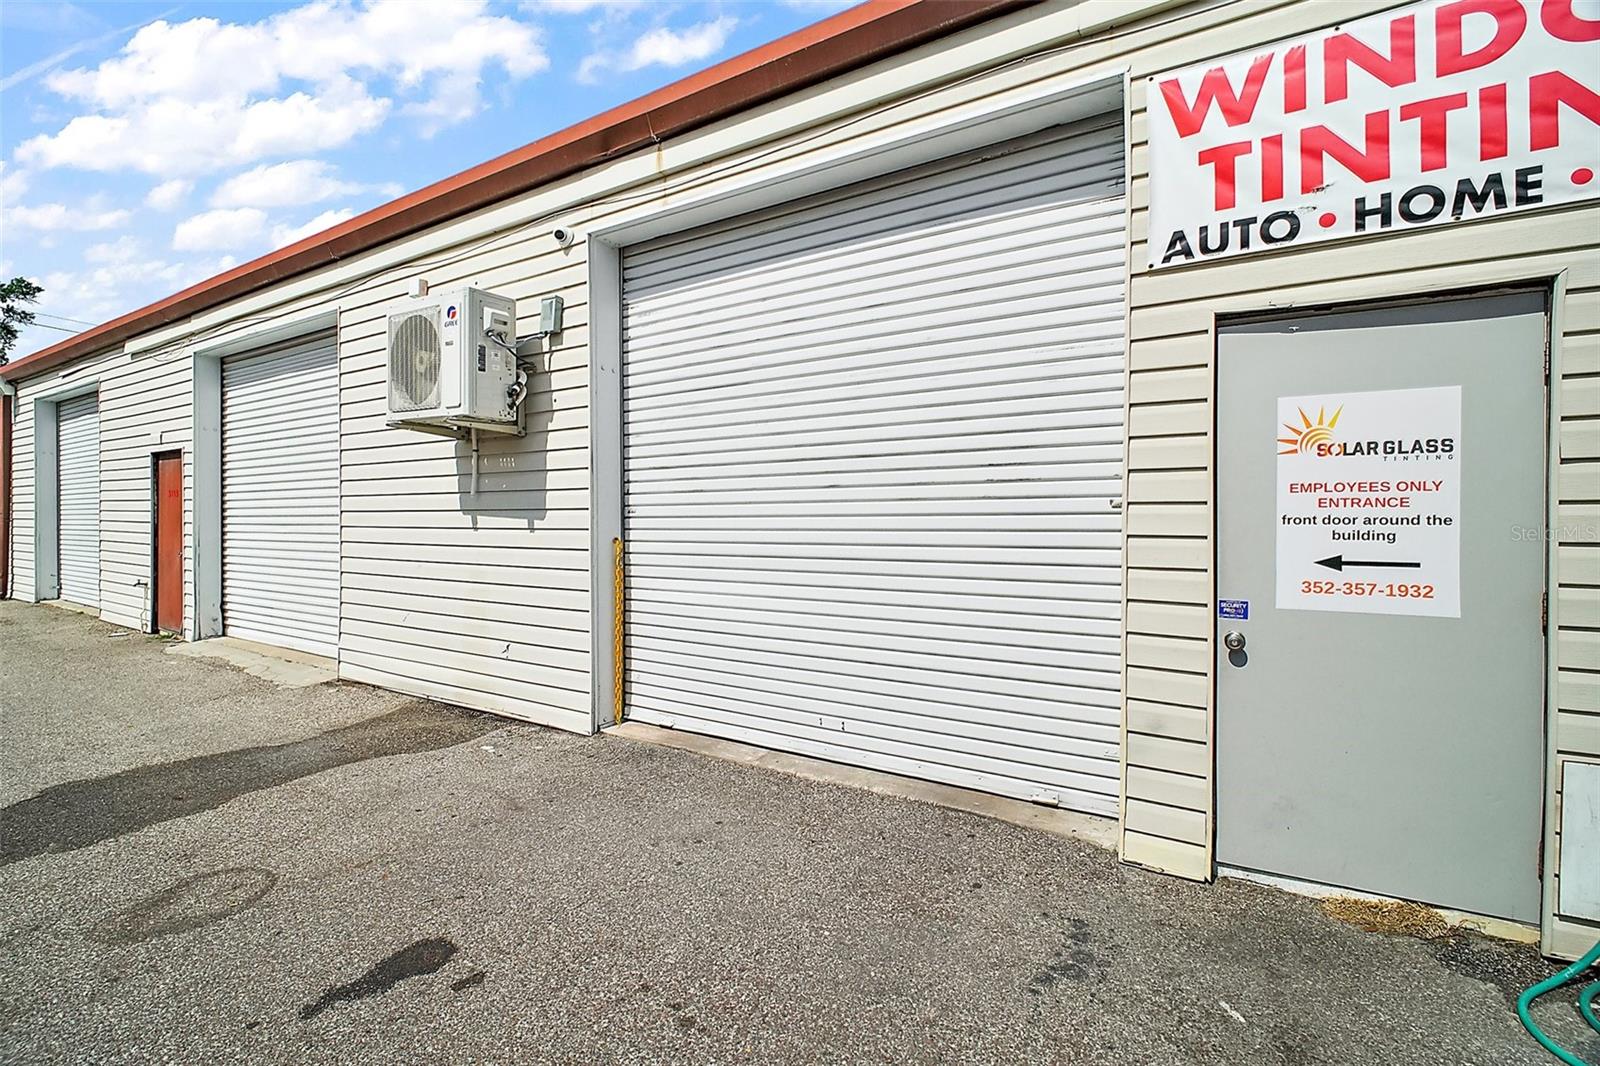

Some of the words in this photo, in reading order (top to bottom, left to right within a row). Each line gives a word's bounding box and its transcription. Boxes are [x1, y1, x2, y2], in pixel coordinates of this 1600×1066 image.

[1161, 210, 1301, 264] AUTO
[1354, 165, 1544, 232] HOME
[1383, 454, 1454, 462] TINTING
[1289, 481, 1391, 494] EMPLOYEES
[1396, 480, 1443, 493] ONLY
[1317, 496, 1411, 508] ENTRANCE
[1281, 514, 1318, 526] front
[1322, 514, 1359, 526] door
[1363, 514, 1421, 526] around
[1426, 514, 1453, 526] the
[1331, 529, 1397, 544] building
[1301, 580, 1434, 599] 352-357-1932
